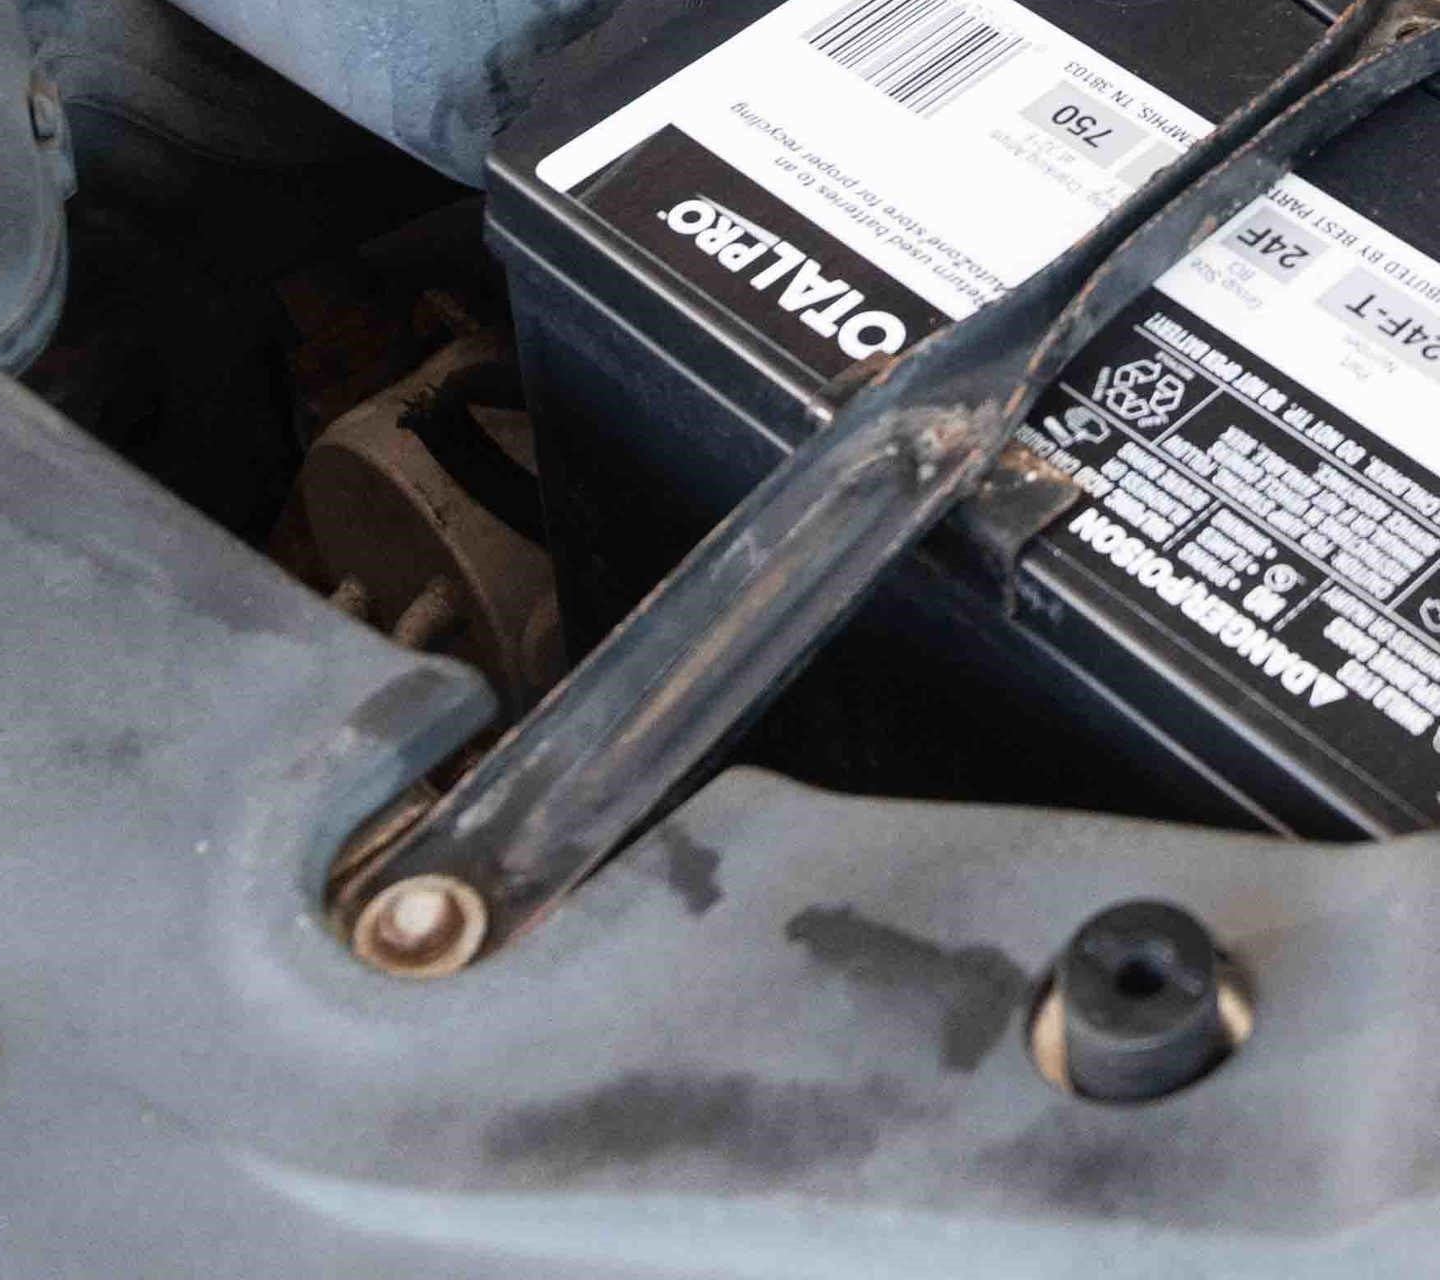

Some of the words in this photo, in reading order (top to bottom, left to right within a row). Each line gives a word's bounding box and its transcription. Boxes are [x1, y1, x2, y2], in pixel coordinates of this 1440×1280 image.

[1063, 61, 1113, 93] 38103
[1109, 89, 1134, 108] TN
[729, 102, 802, 152] recycling
[1051, 105, 1112, 147] 750
[1137, 102, 1202, 149] EMPHIS,
[796, 172, 815, 186] to
[801, 152, 860, 188] proper
[817, 184, 889, 237] batteries
[854, 189, 882, 207] for
[882, 206, 926, 236] store
[1311, 216, 1358, 248] BEST
[885, 235, 932, 264] used
[1236, 228, 1308, 268] 24F
[1357, 244, 1384, 264] BY
[657, 194, 906, 361] OTALPRO
[931, 265, 992, 309] Return
[1198, 348, 1242, 382] OPEN
[1067, 507, 1325, 694] DANGER/POISON
[1242, 584, 1287, 622] NO
